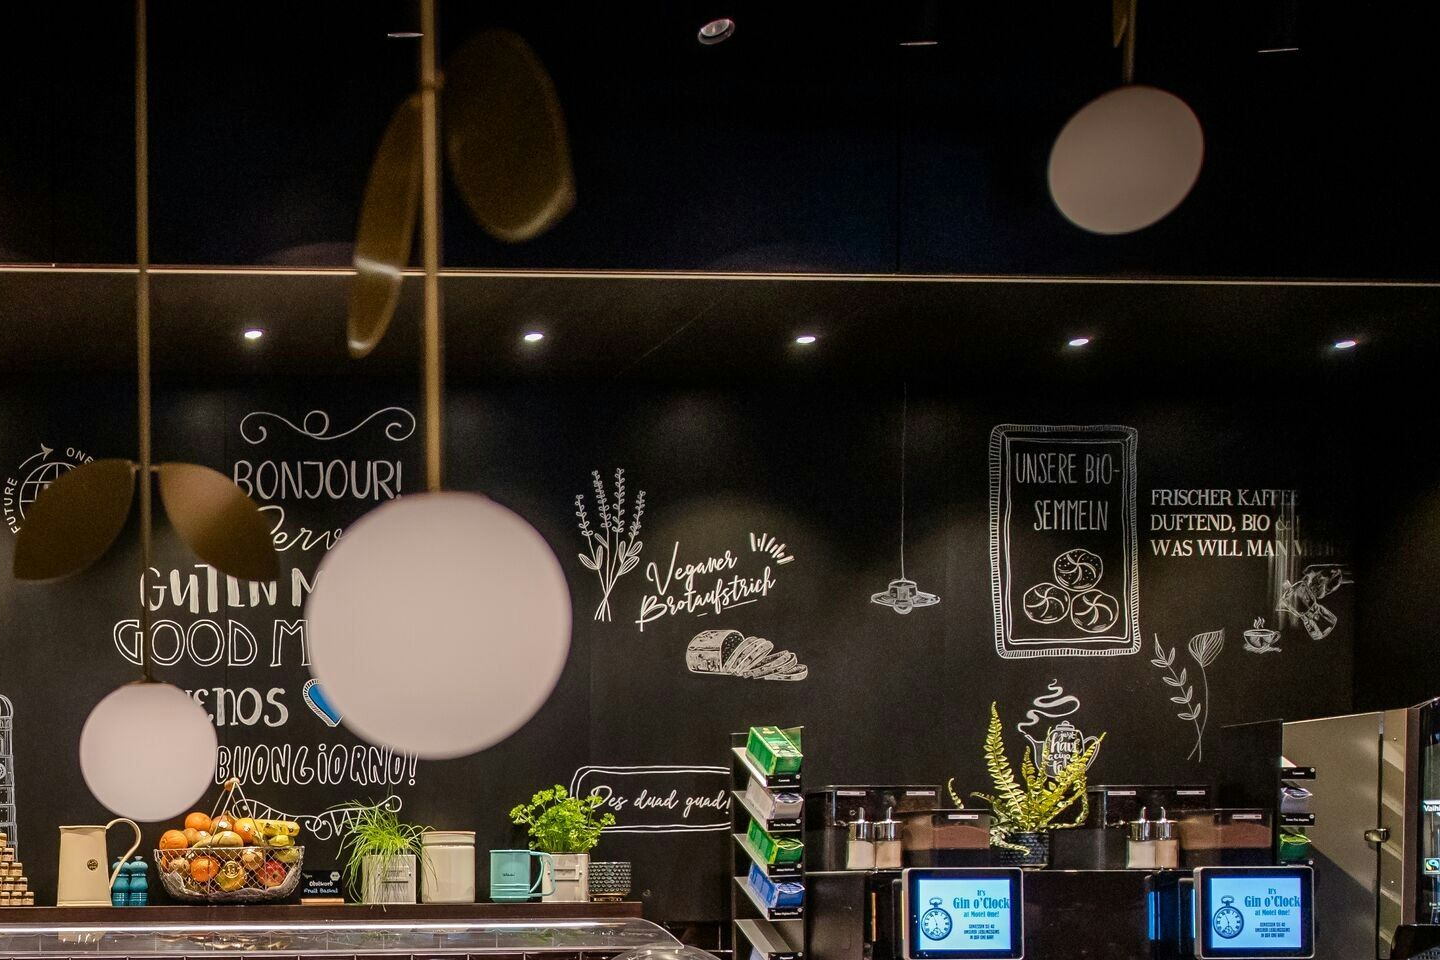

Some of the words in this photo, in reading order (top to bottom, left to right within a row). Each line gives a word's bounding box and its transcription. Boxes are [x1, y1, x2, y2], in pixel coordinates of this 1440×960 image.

[66, 447, 94, 465] ONE
[1015, 453, 1077, 484] UNSERE
[233, 458, 402, 500] BONJOUR!
[3, 477, 21, 534] FUTURE
[1151, 489, 1234, 506] FRISCHER
[1033, 500, 1108, 531] SEMMELN
[1150, 514, 1236, 533] DUFTEND,
[1241, 514, 1271, 531] BIO
[1150, 539, 1193, 557] WAS
[1197, 539, 1243, 557] WILL
[1246, 539, 1289, 557] MAN
[646, 541, 738, 595] Veganer
[634, 566, 776, 632] Brotaufstrich
[113, 619, 258, 667] GOOD
[634, 789, 679, 809] duad
[683, 789, 731, 818] guad!
[953, 897, 970, 909] Gin
[973, 897, 1010, 909] o'Clock
[1244, 896, 1261, 907] Gin
[1264, 895, 1301, 907] o'Clock
